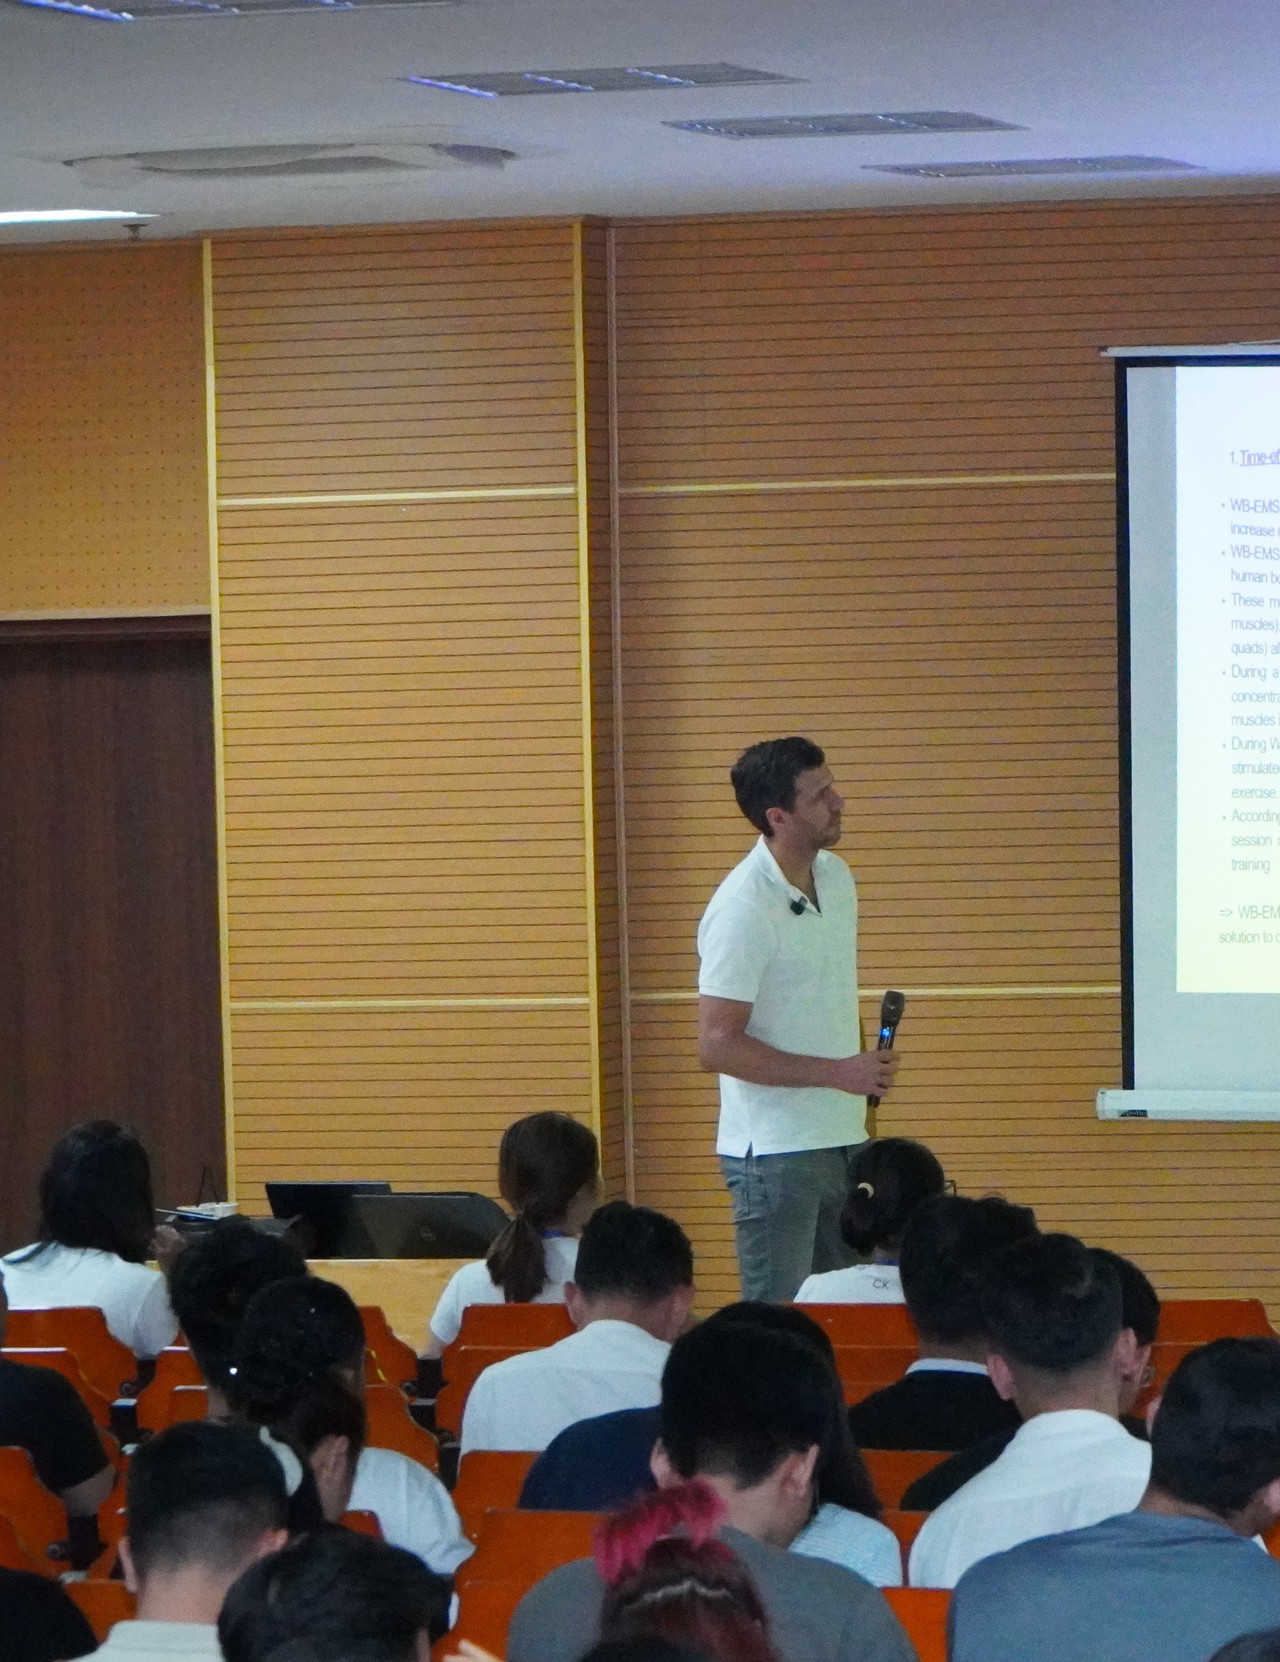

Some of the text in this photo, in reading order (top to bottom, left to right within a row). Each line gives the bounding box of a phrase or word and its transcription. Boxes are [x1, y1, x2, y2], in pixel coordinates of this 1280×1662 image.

[1230, 450, 1239, 465] 1.
[1229, 497, 1280, 513] WB-EMS
[1230, 521, 1276, 537] increase
[1230, 543, 1280, 561] WB-EMS
[1230, 568, 1268, 583] human
[1230, 592, 1265, 607] These
[1230, 640, 1268, 656] quads)
[1231, 663, 1267, 681] During
[1231, 712, 1276, 726] muscles
[1231, 735, 1267, 753] During
[1230, 833, 1273, 846] session
[1230, 858, 1271, 874] training
[1218, 929, 1260, 943] solution
[1262, 931, 1274, 943] to
[872, 1279, 889, 1290] CK
